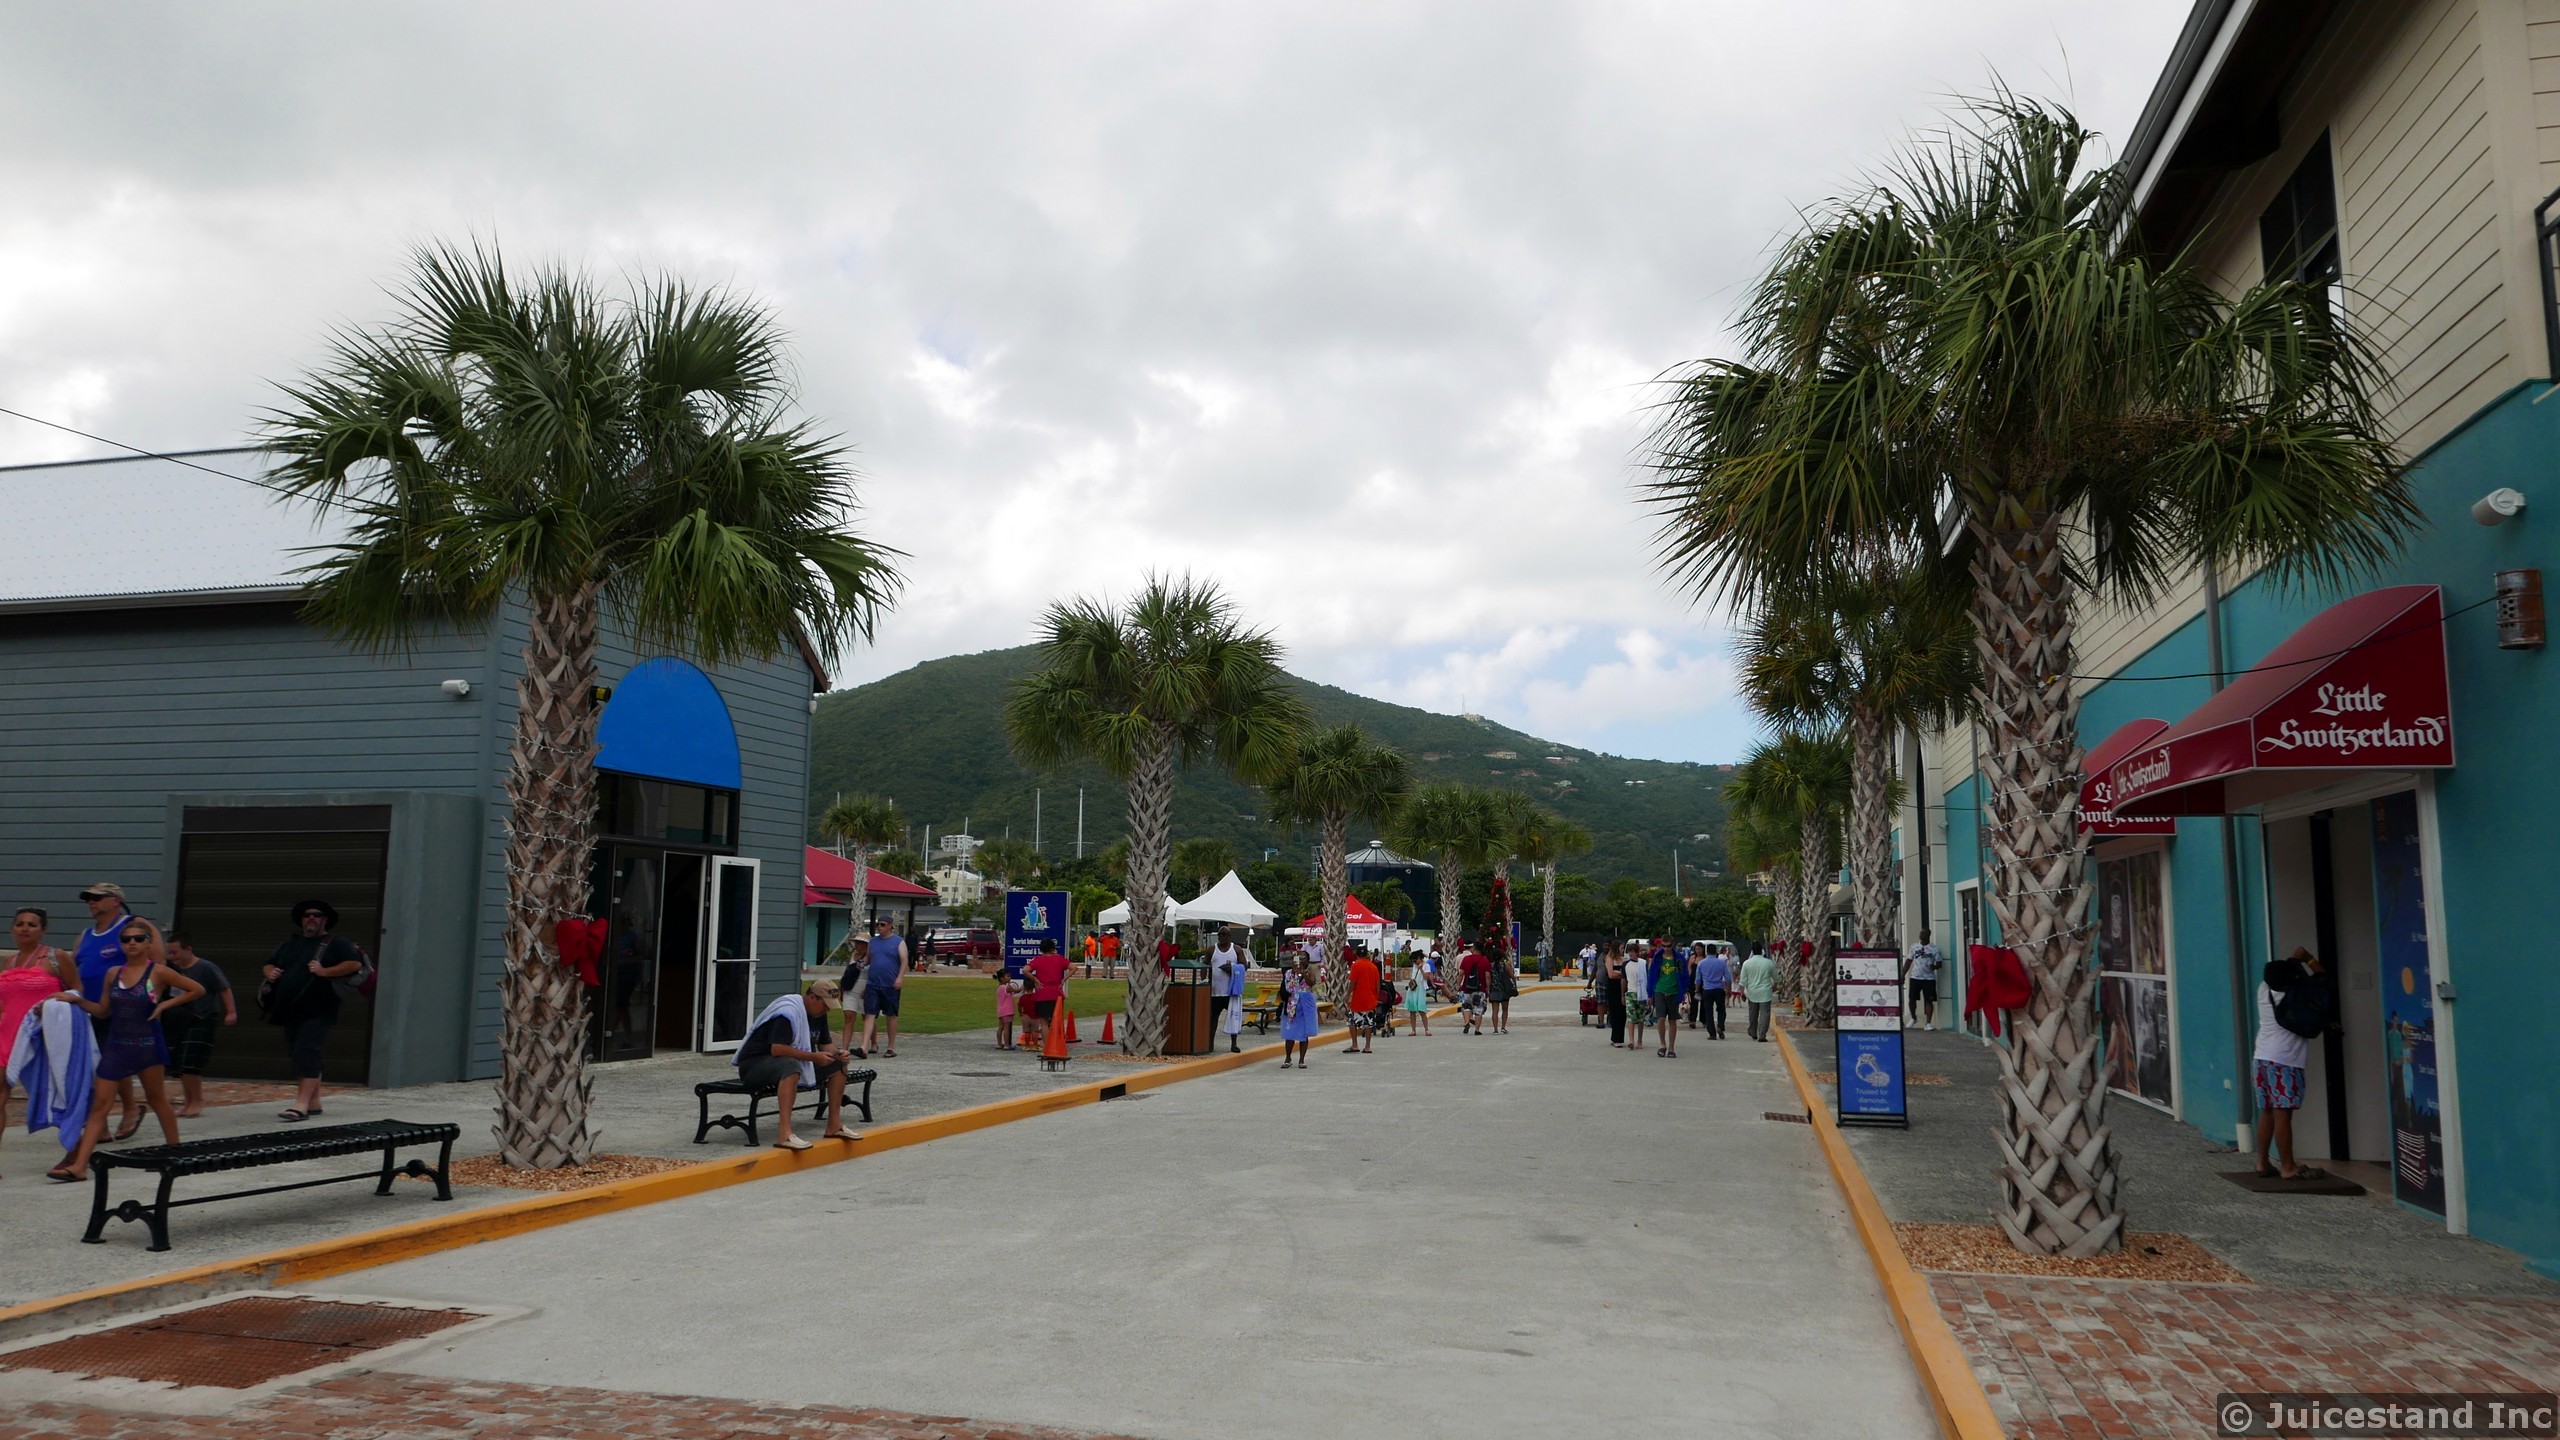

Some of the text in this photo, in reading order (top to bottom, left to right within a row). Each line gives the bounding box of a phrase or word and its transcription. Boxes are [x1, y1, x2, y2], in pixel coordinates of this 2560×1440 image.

[2310, 682, 2387, 716] Little
[2256, 715, 2446, 756] Switzerland
[1856, 1087, 1879, 1095] Trusted
